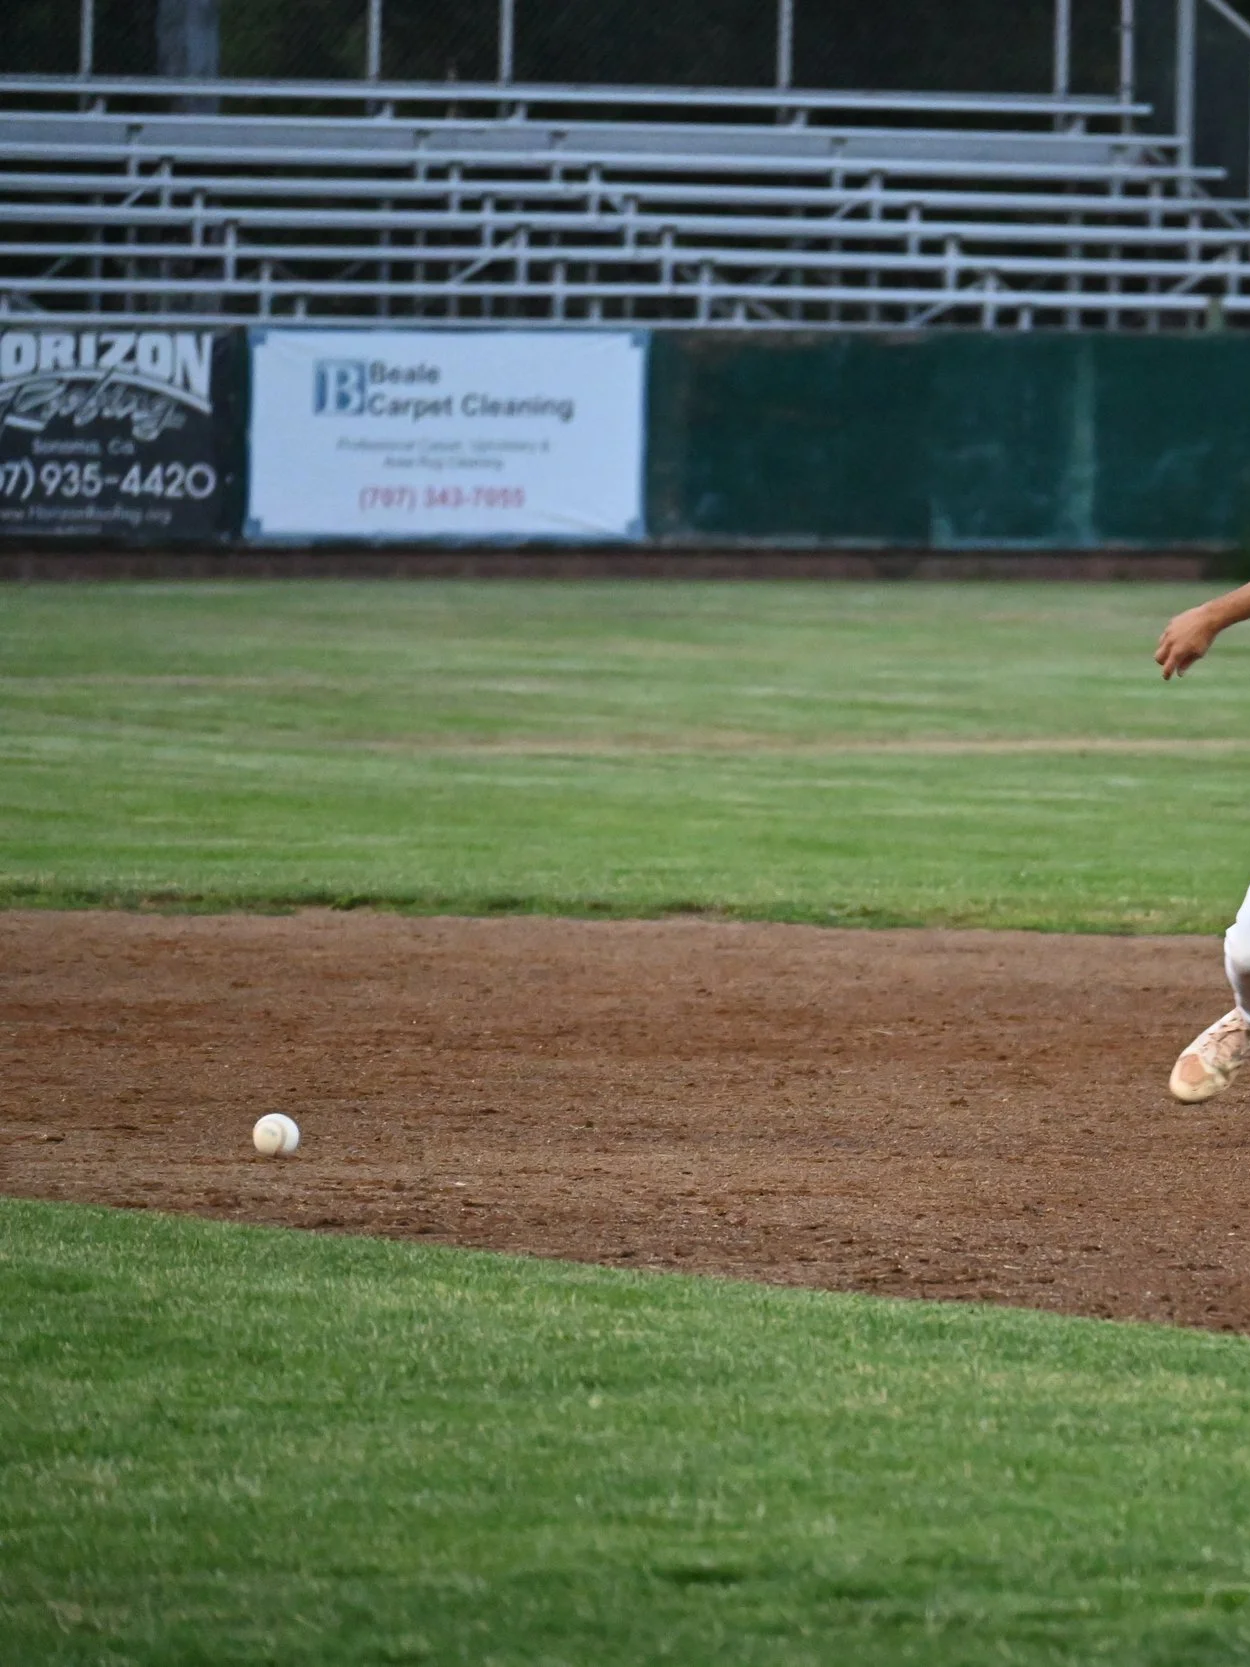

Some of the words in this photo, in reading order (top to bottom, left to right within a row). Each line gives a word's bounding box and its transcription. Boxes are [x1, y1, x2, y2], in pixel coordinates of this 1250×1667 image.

[369, 360, 440, 384] Beale
[368, 392, 452, 422] Carpet
[461, 391, 574, 422] Cleaning
[0, 457, 35, 500] 7)
[40, 460, 217, 499] 935-4420
